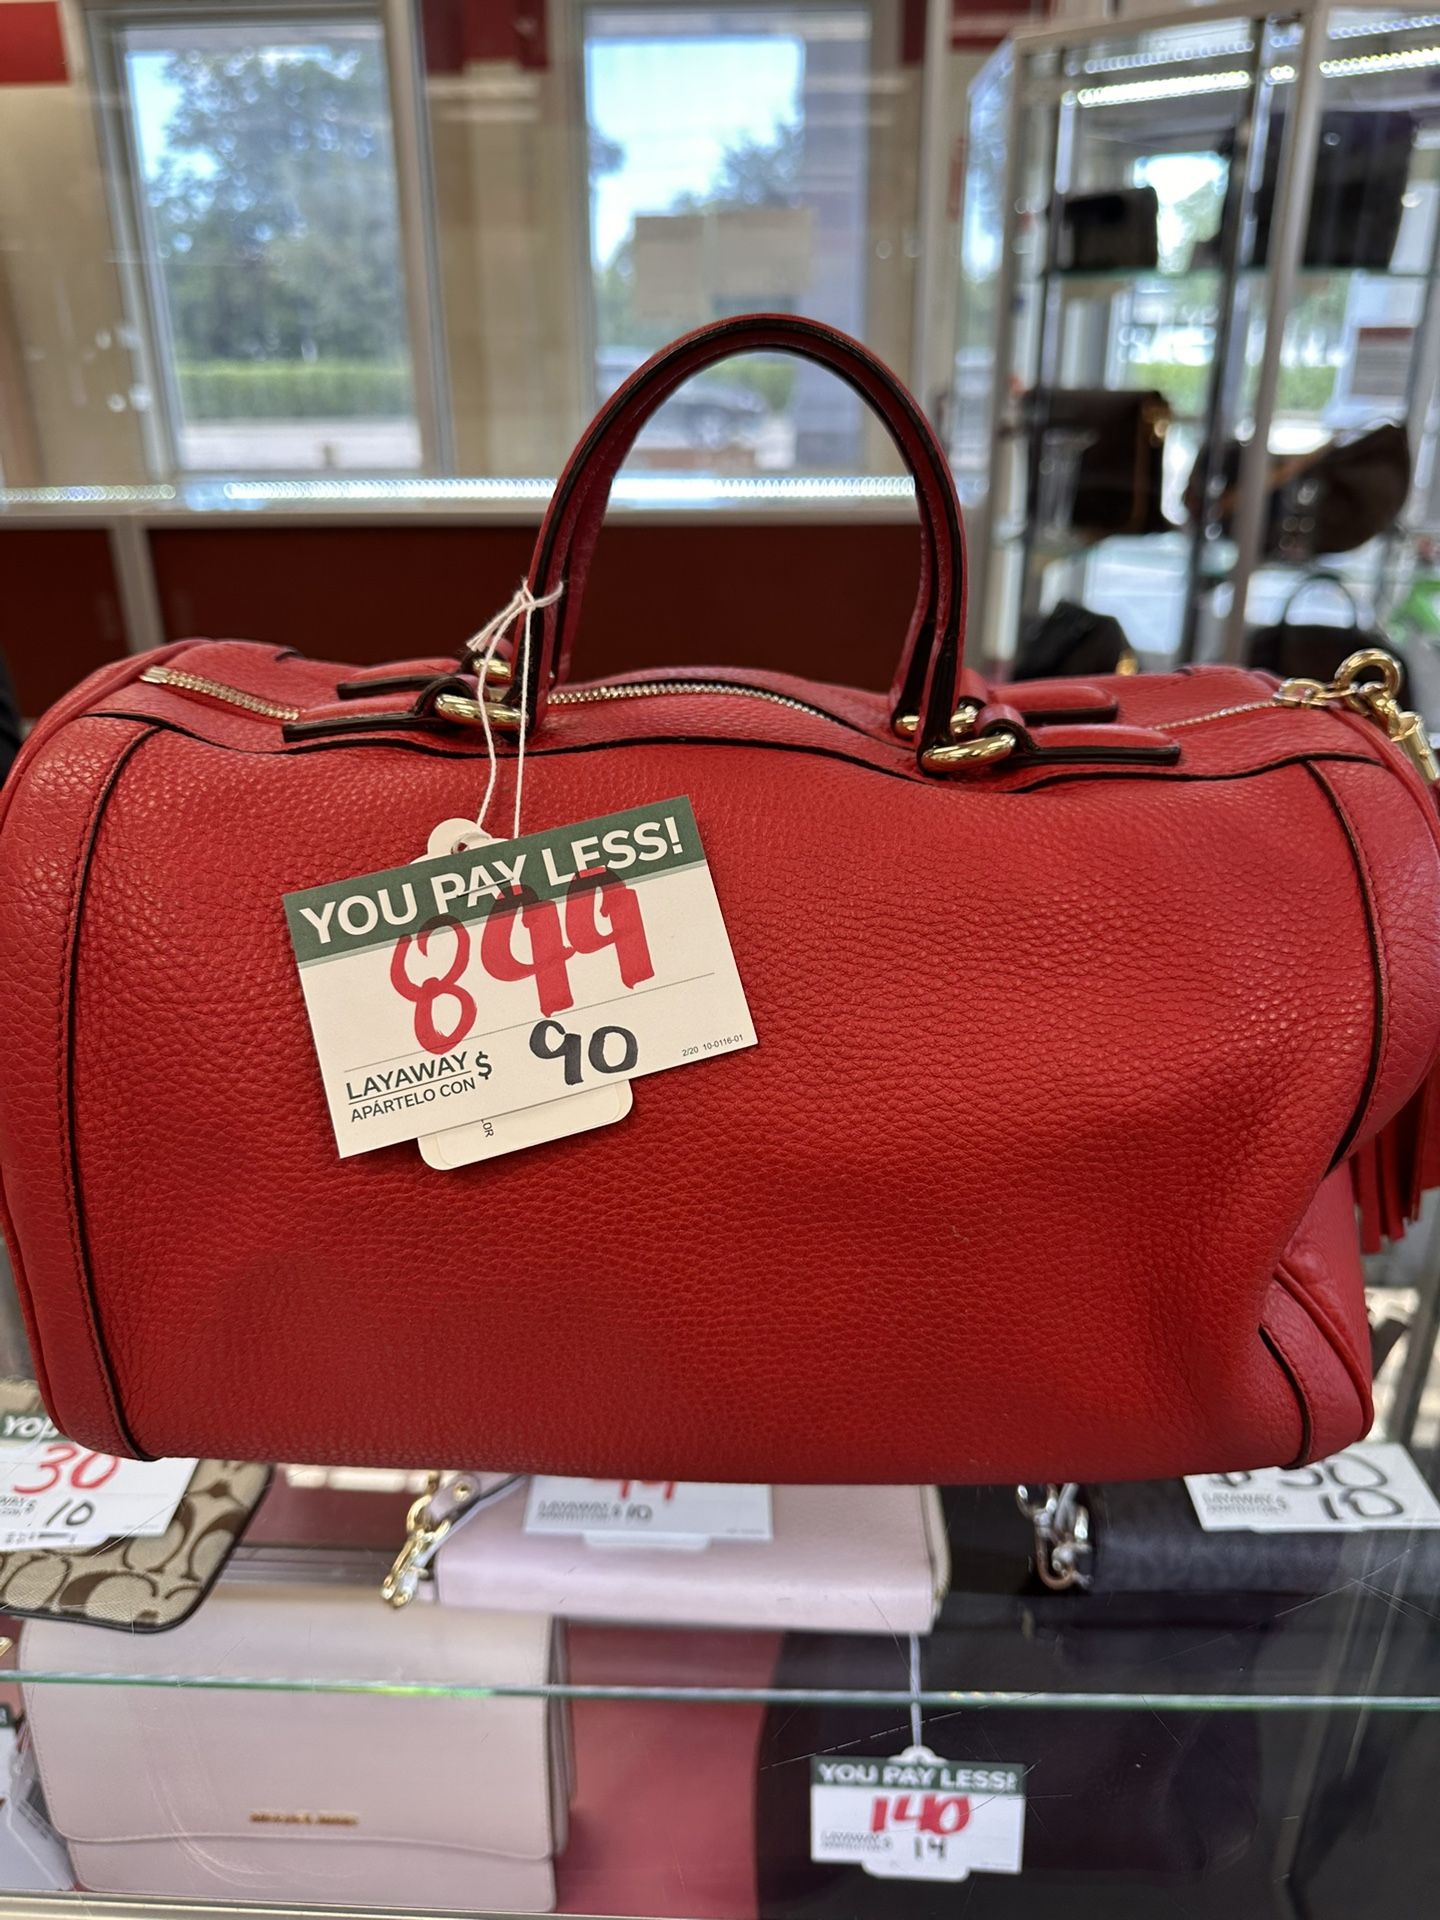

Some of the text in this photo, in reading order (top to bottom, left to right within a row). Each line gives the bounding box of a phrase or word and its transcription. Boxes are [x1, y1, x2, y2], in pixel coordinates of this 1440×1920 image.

[300, 816, 683, 943] YOU PAY LESS!
[346, 1019, 639, 1099] LAYAWAY $ 90
[682, 1034, 744, 1057] 2/20 10-0116-01
[351, 1077, 476, 1122] APÁRTELO CON
[481, 1119, 495, 1138] OR
[13, 1443, 120, 1494] 30
[45, 1498, 96, 1528] 10
[1319, 1488, 1405, 1521] 10
[818, 1763, 1018, 1791] YOU PAY LESS!
[870, 1793, 972, 1836] 140
[914, 1836, 947, 1860] 14
